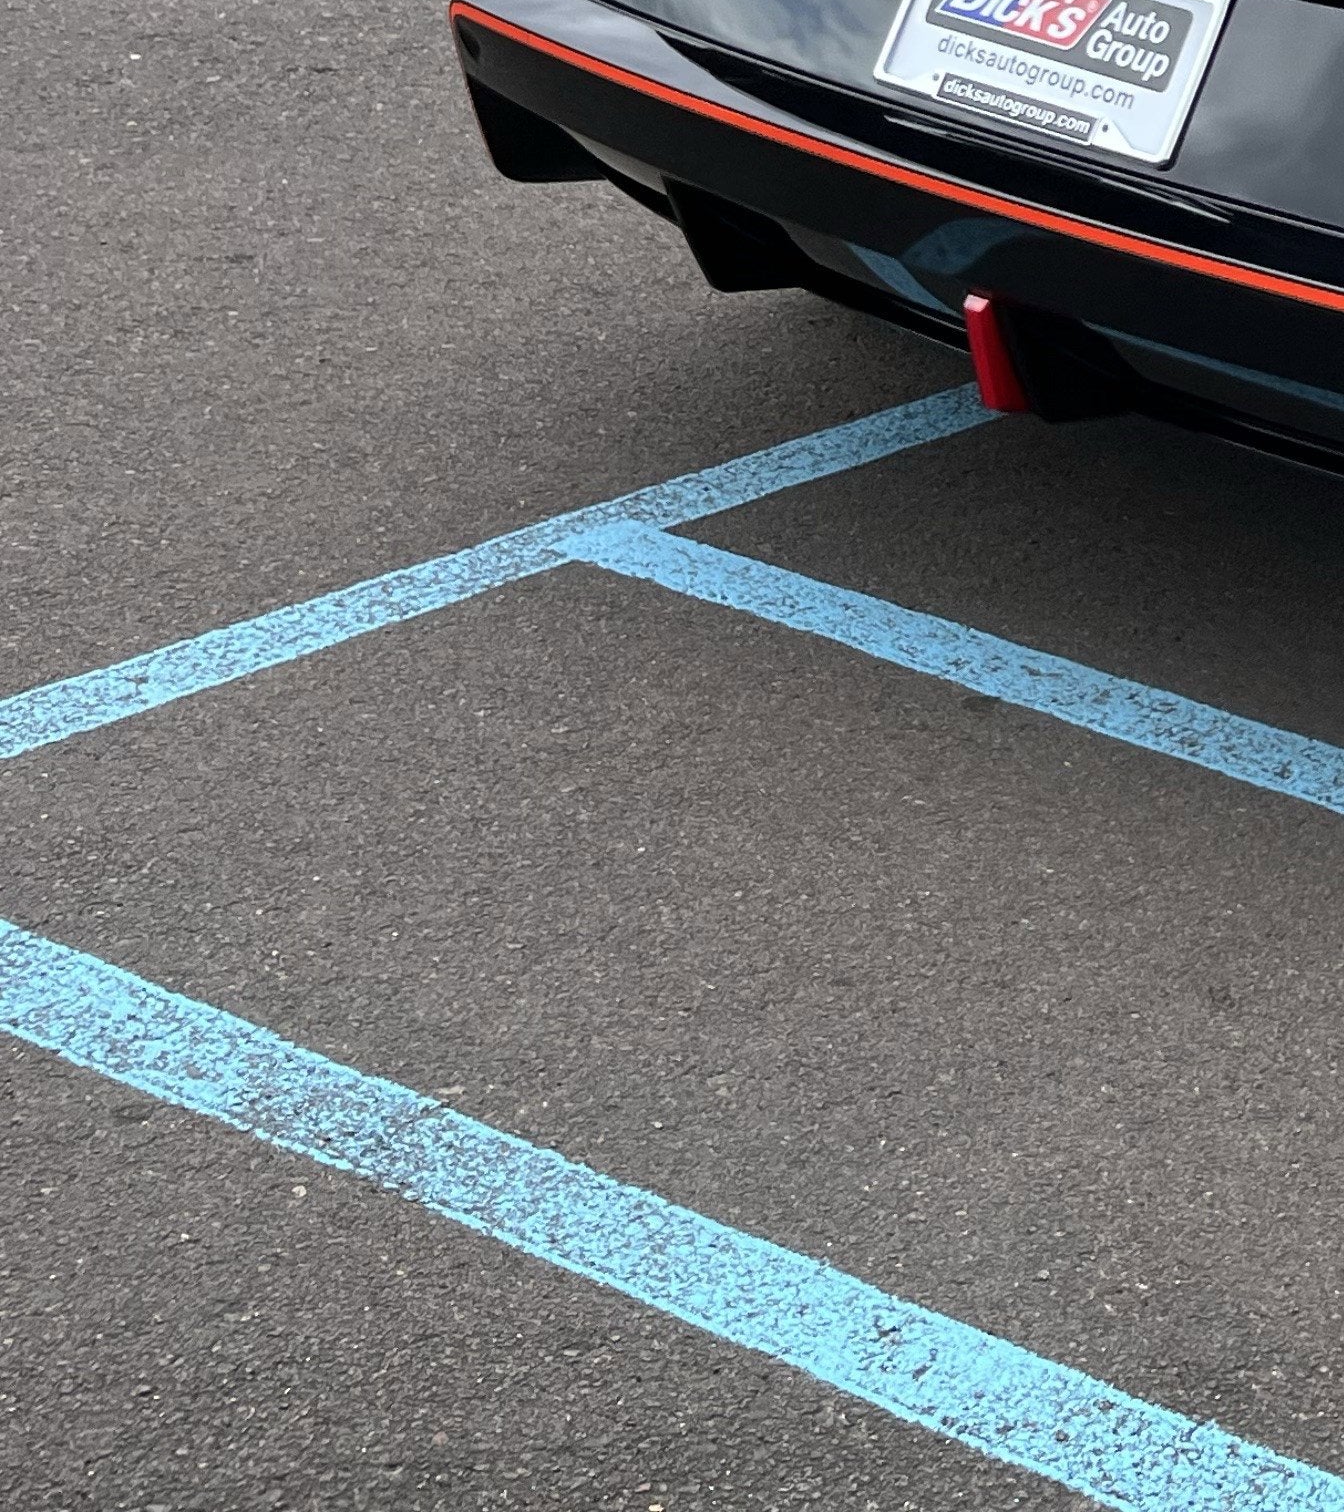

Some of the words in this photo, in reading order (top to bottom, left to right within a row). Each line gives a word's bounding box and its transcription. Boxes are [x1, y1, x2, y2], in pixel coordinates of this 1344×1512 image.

[1100, 1, 1170, 44] Auto
[937, 35, 1136, 110] dicksautogroup.com
[1086, 28, 1171, 82] Group
[943, 76, 1092, 135] dicksautogroup.com
